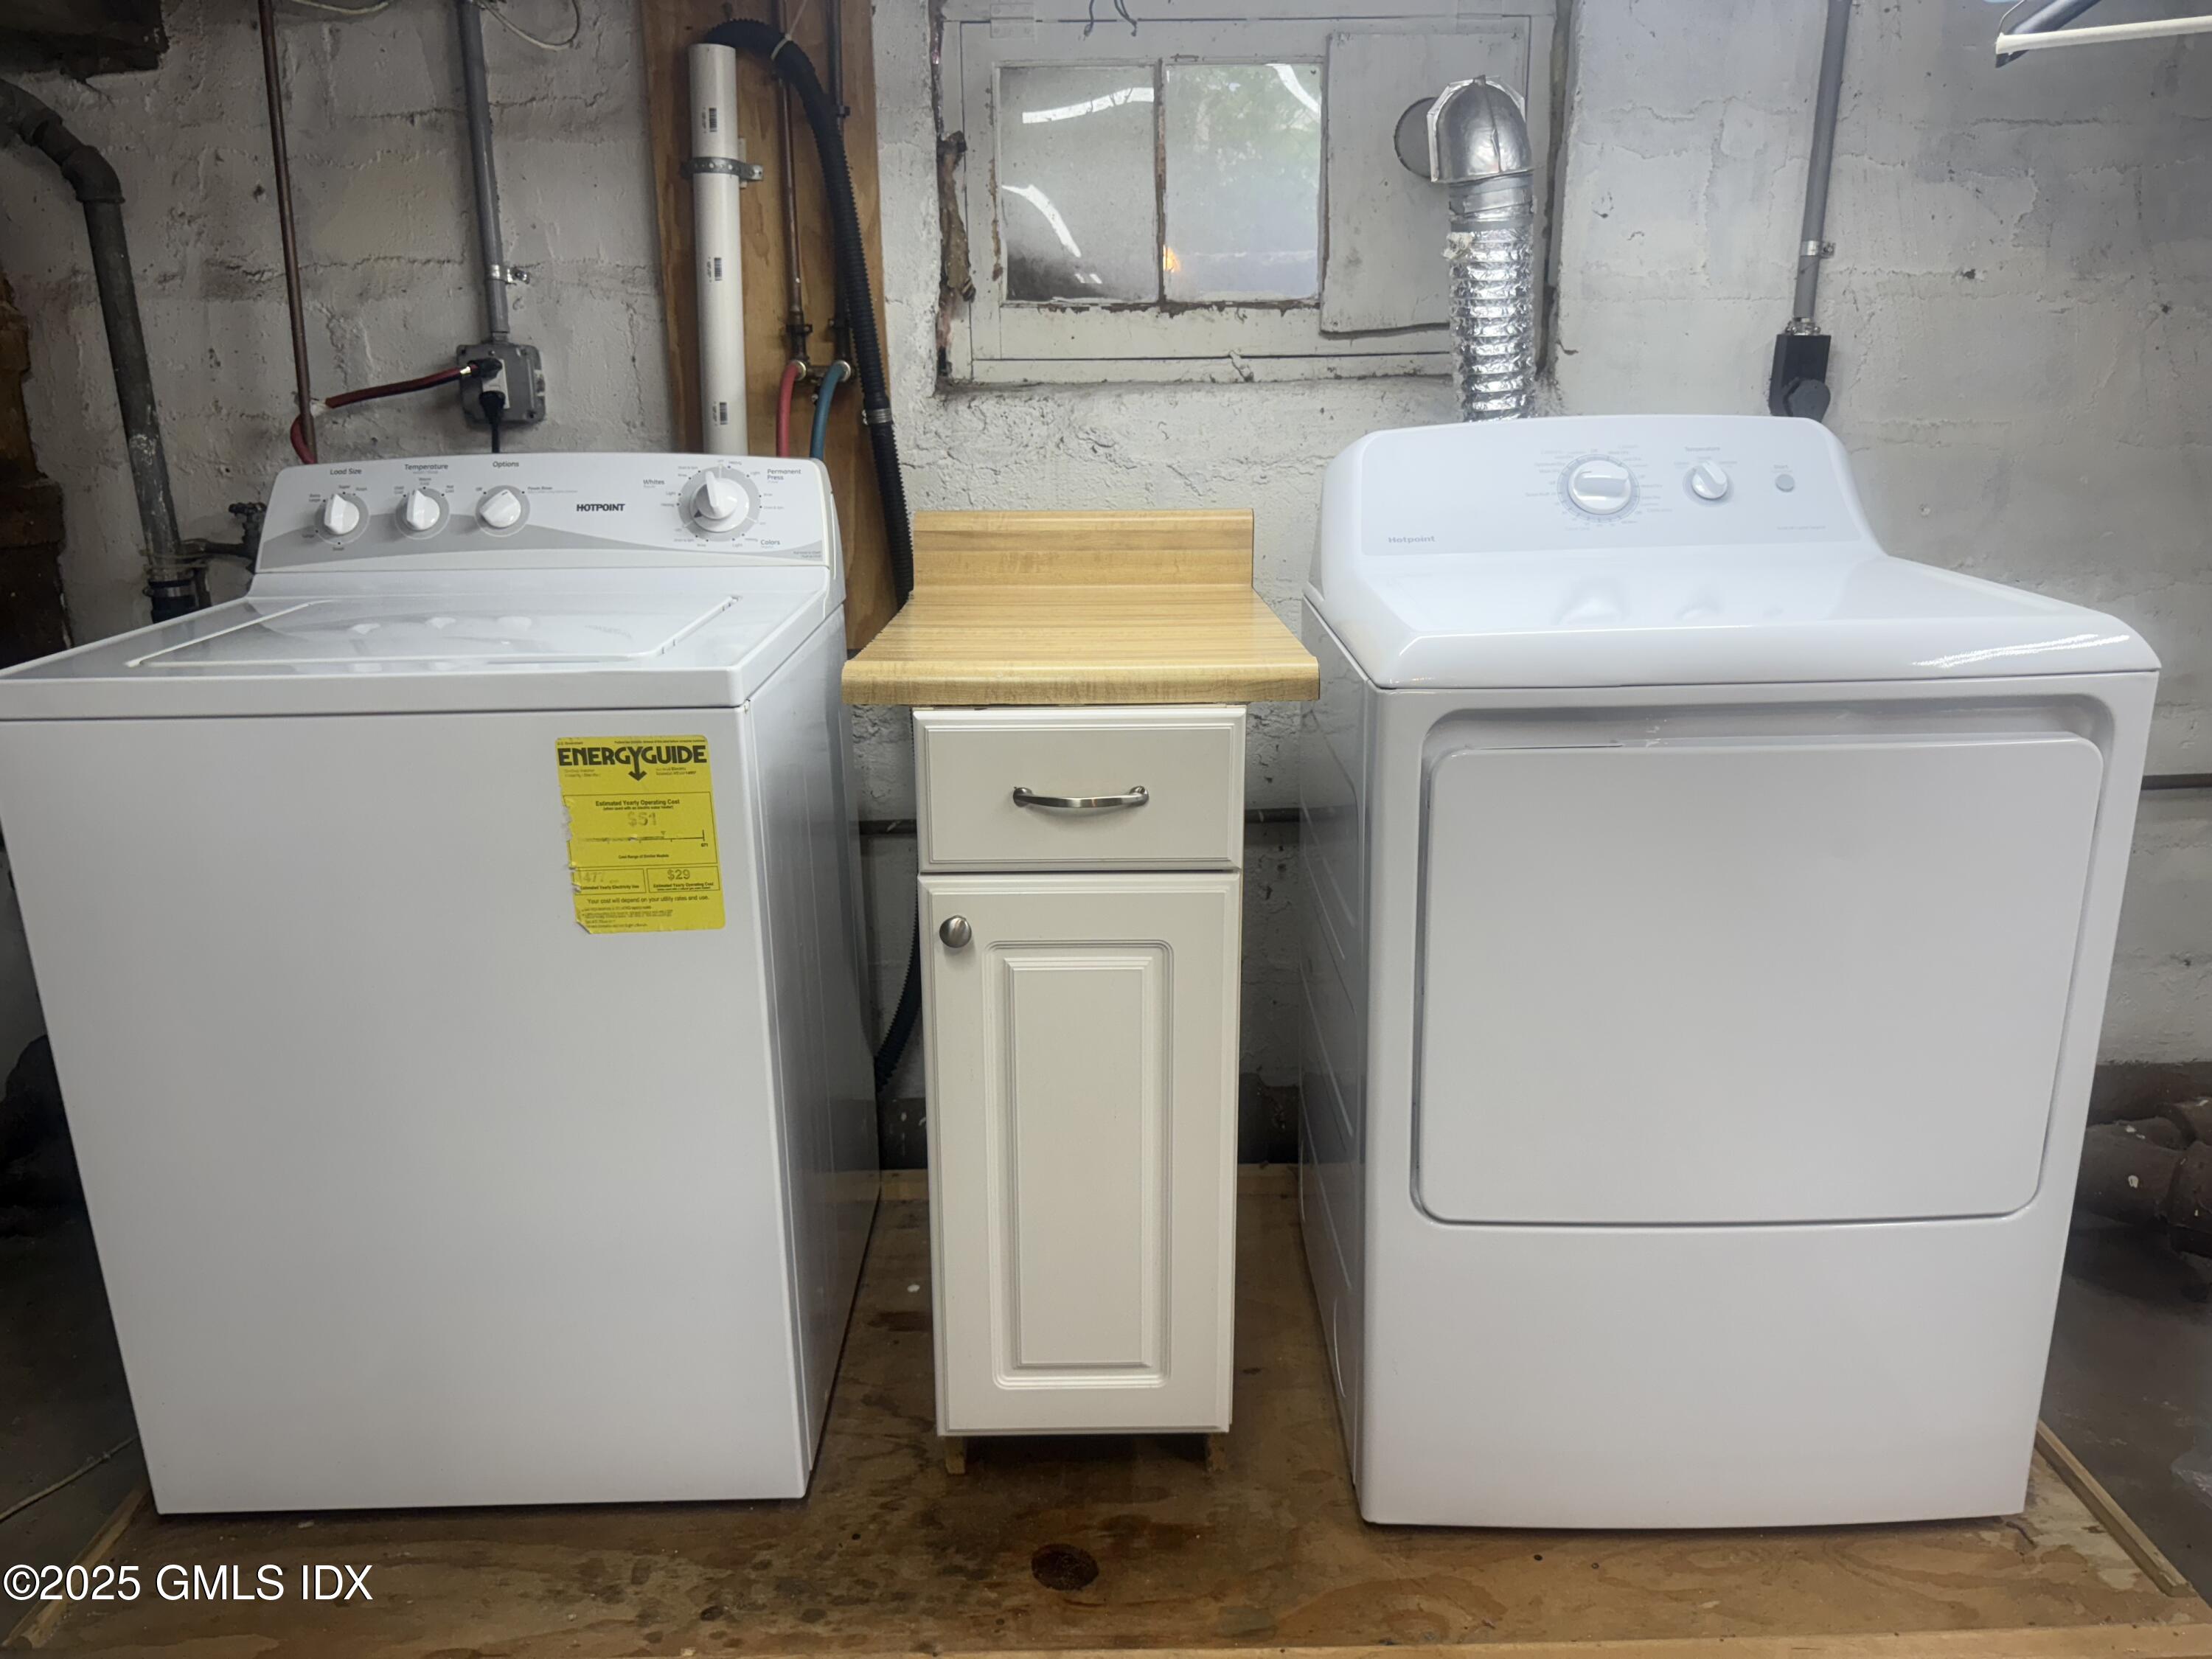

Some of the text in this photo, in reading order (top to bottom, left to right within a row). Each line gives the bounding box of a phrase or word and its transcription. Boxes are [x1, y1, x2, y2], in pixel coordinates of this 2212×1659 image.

[577, 504, 625, 512] HOTPOINT
[1388, 535, 1436, 544] Hotpoint
[557, 745, 707, 766] ENERGYGUIDE
[627, 812, 657, 827] $51
[667, 869, 690, 880] $29
